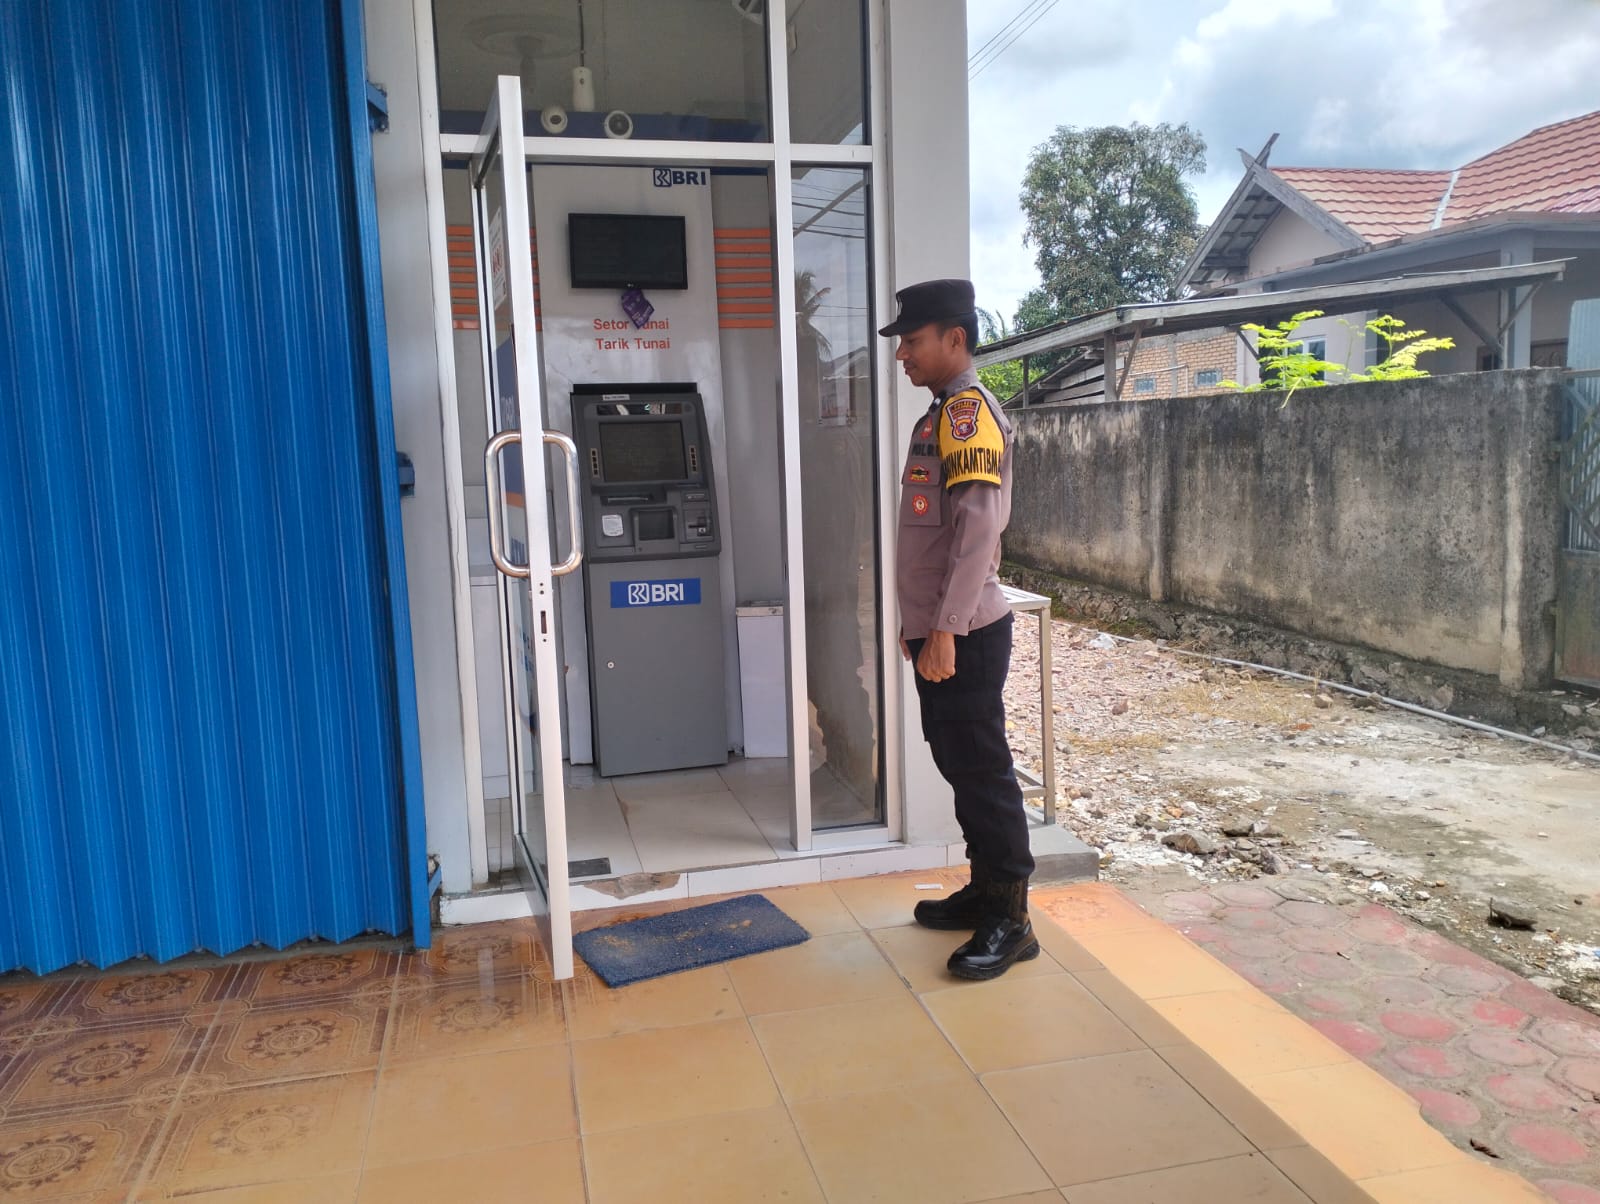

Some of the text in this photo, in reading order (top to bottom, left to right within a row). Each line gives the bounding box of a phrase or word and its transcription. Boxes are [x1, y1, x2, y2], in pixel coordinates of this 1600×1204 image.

[672, 170, 707, 186] BRI
[593, 318, 669, 330] Setor unai
[595, 338, 670, 350] Tarik Tunai
[651, 583, 684, 602] BRI
